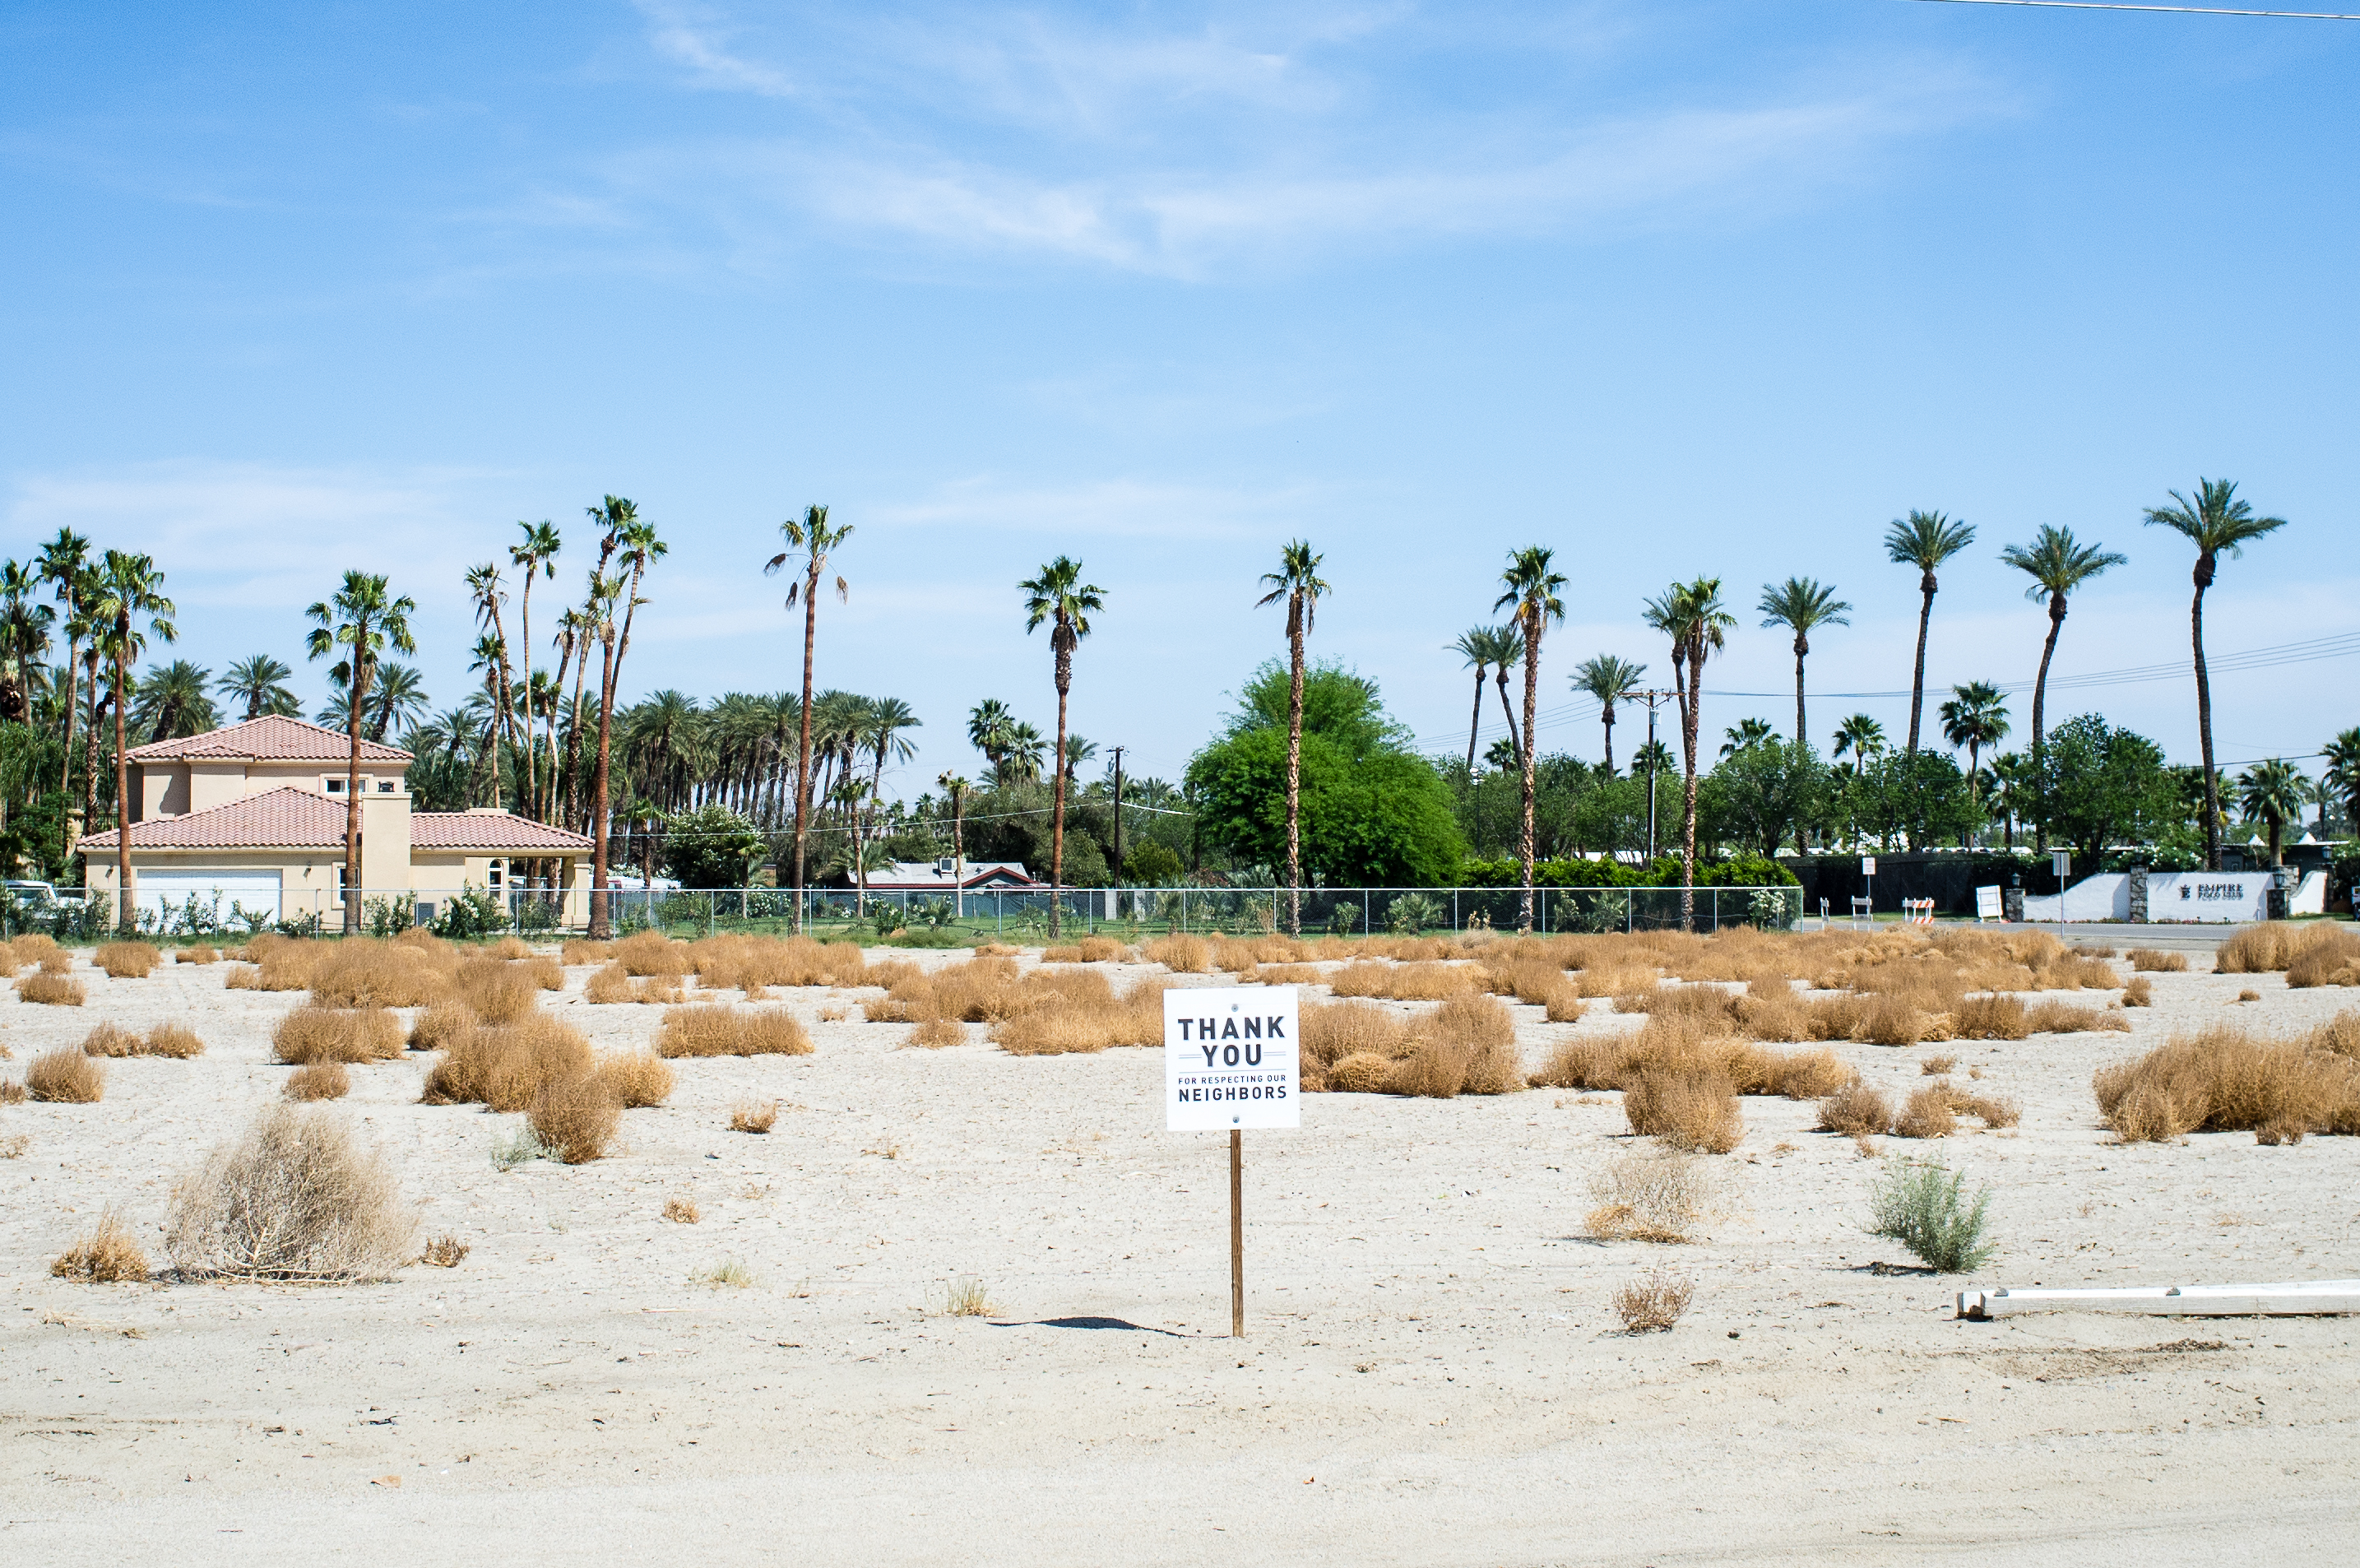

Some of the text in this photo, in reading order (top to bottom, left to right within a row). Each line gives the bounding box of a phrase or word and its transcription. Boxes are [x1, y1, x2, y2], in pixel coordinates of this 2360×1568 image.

[2198, 884, 2243, 892] EMPIRE
[1177, 1016, 1286, 1041] THANK
[1202, 1044, 1262, 1067] YOU
[1178, 1074, 1287, 1085] FOR RESPECTING OUR
[1179, 1086, 1287, 1102] NEIGHBORS
